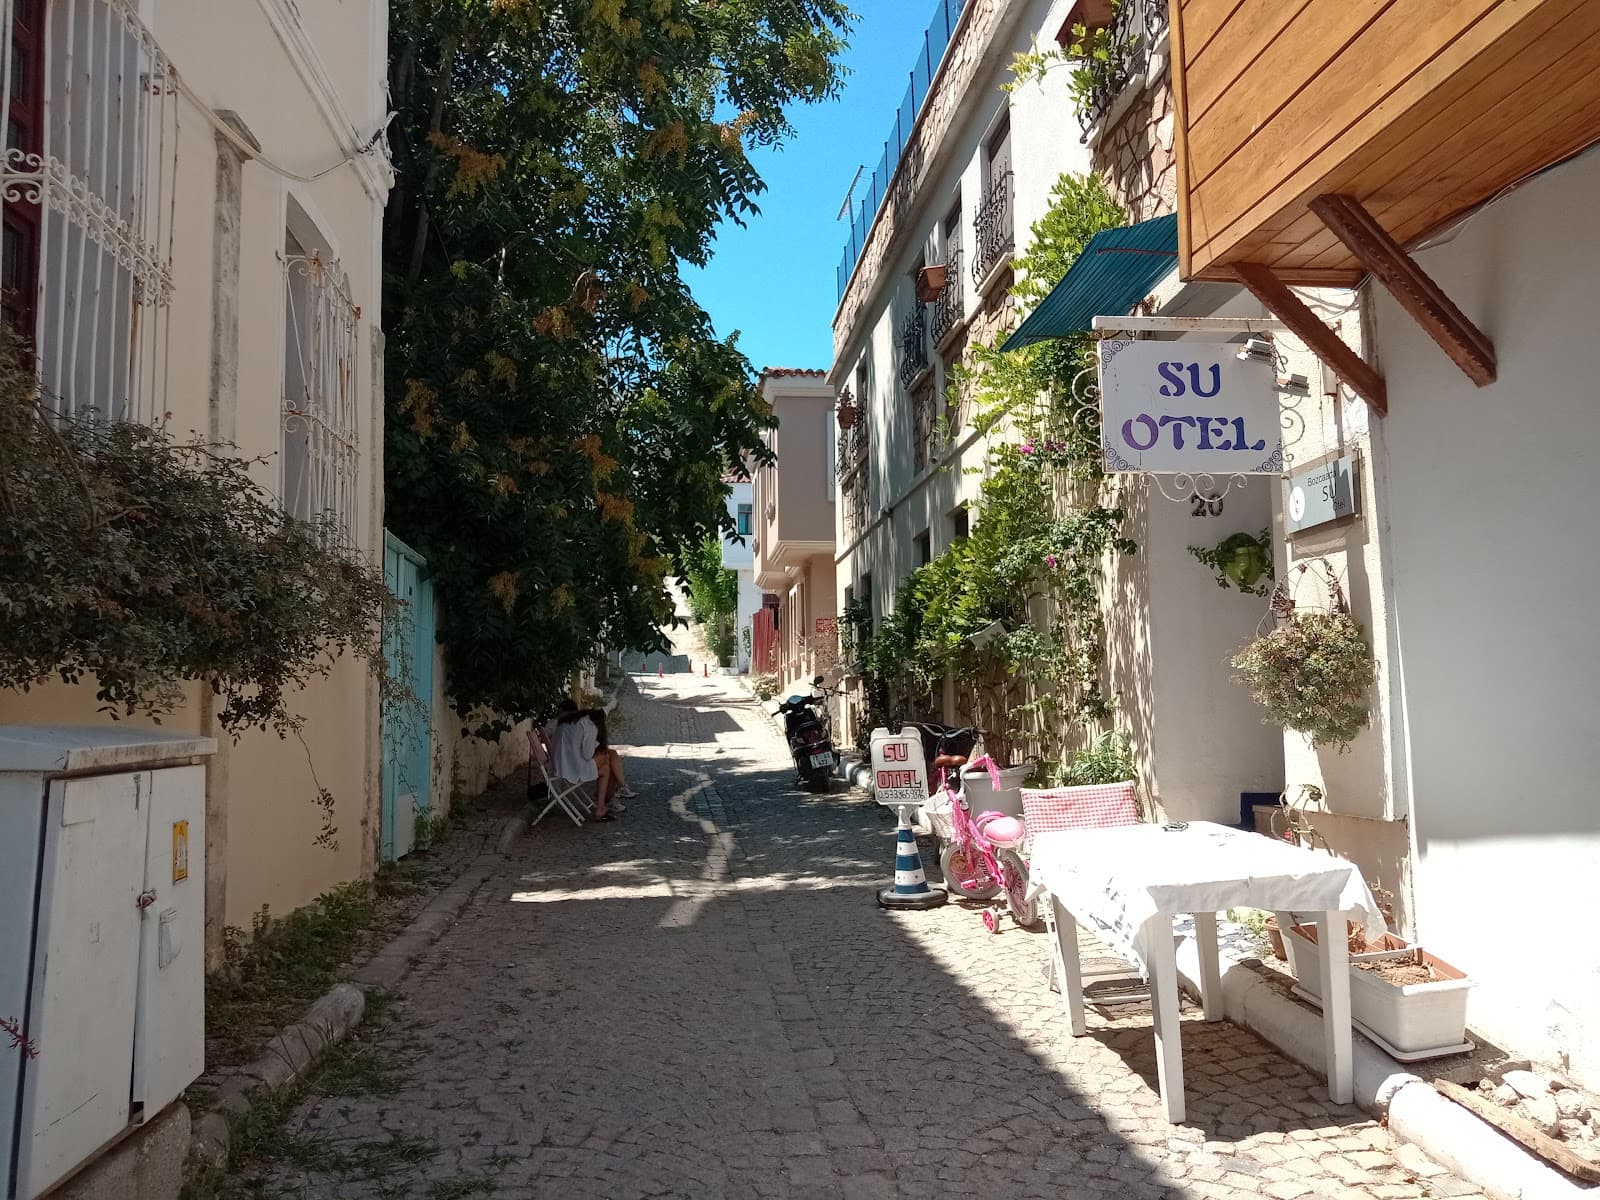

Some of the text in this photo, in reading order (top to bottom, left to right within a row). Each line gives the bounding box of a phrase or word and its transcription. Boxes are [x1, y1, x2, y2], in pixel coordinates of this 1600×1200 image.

[1157, 361, 1221, 398] SU
[1121, 413, 1266, 451] OTEL
[1322, 480, 1337, 502] SU
[1190, 493, 1224, 517] 20
[883, 744, 908, 761] SU
[877, 770, 921, 788] OTEL
